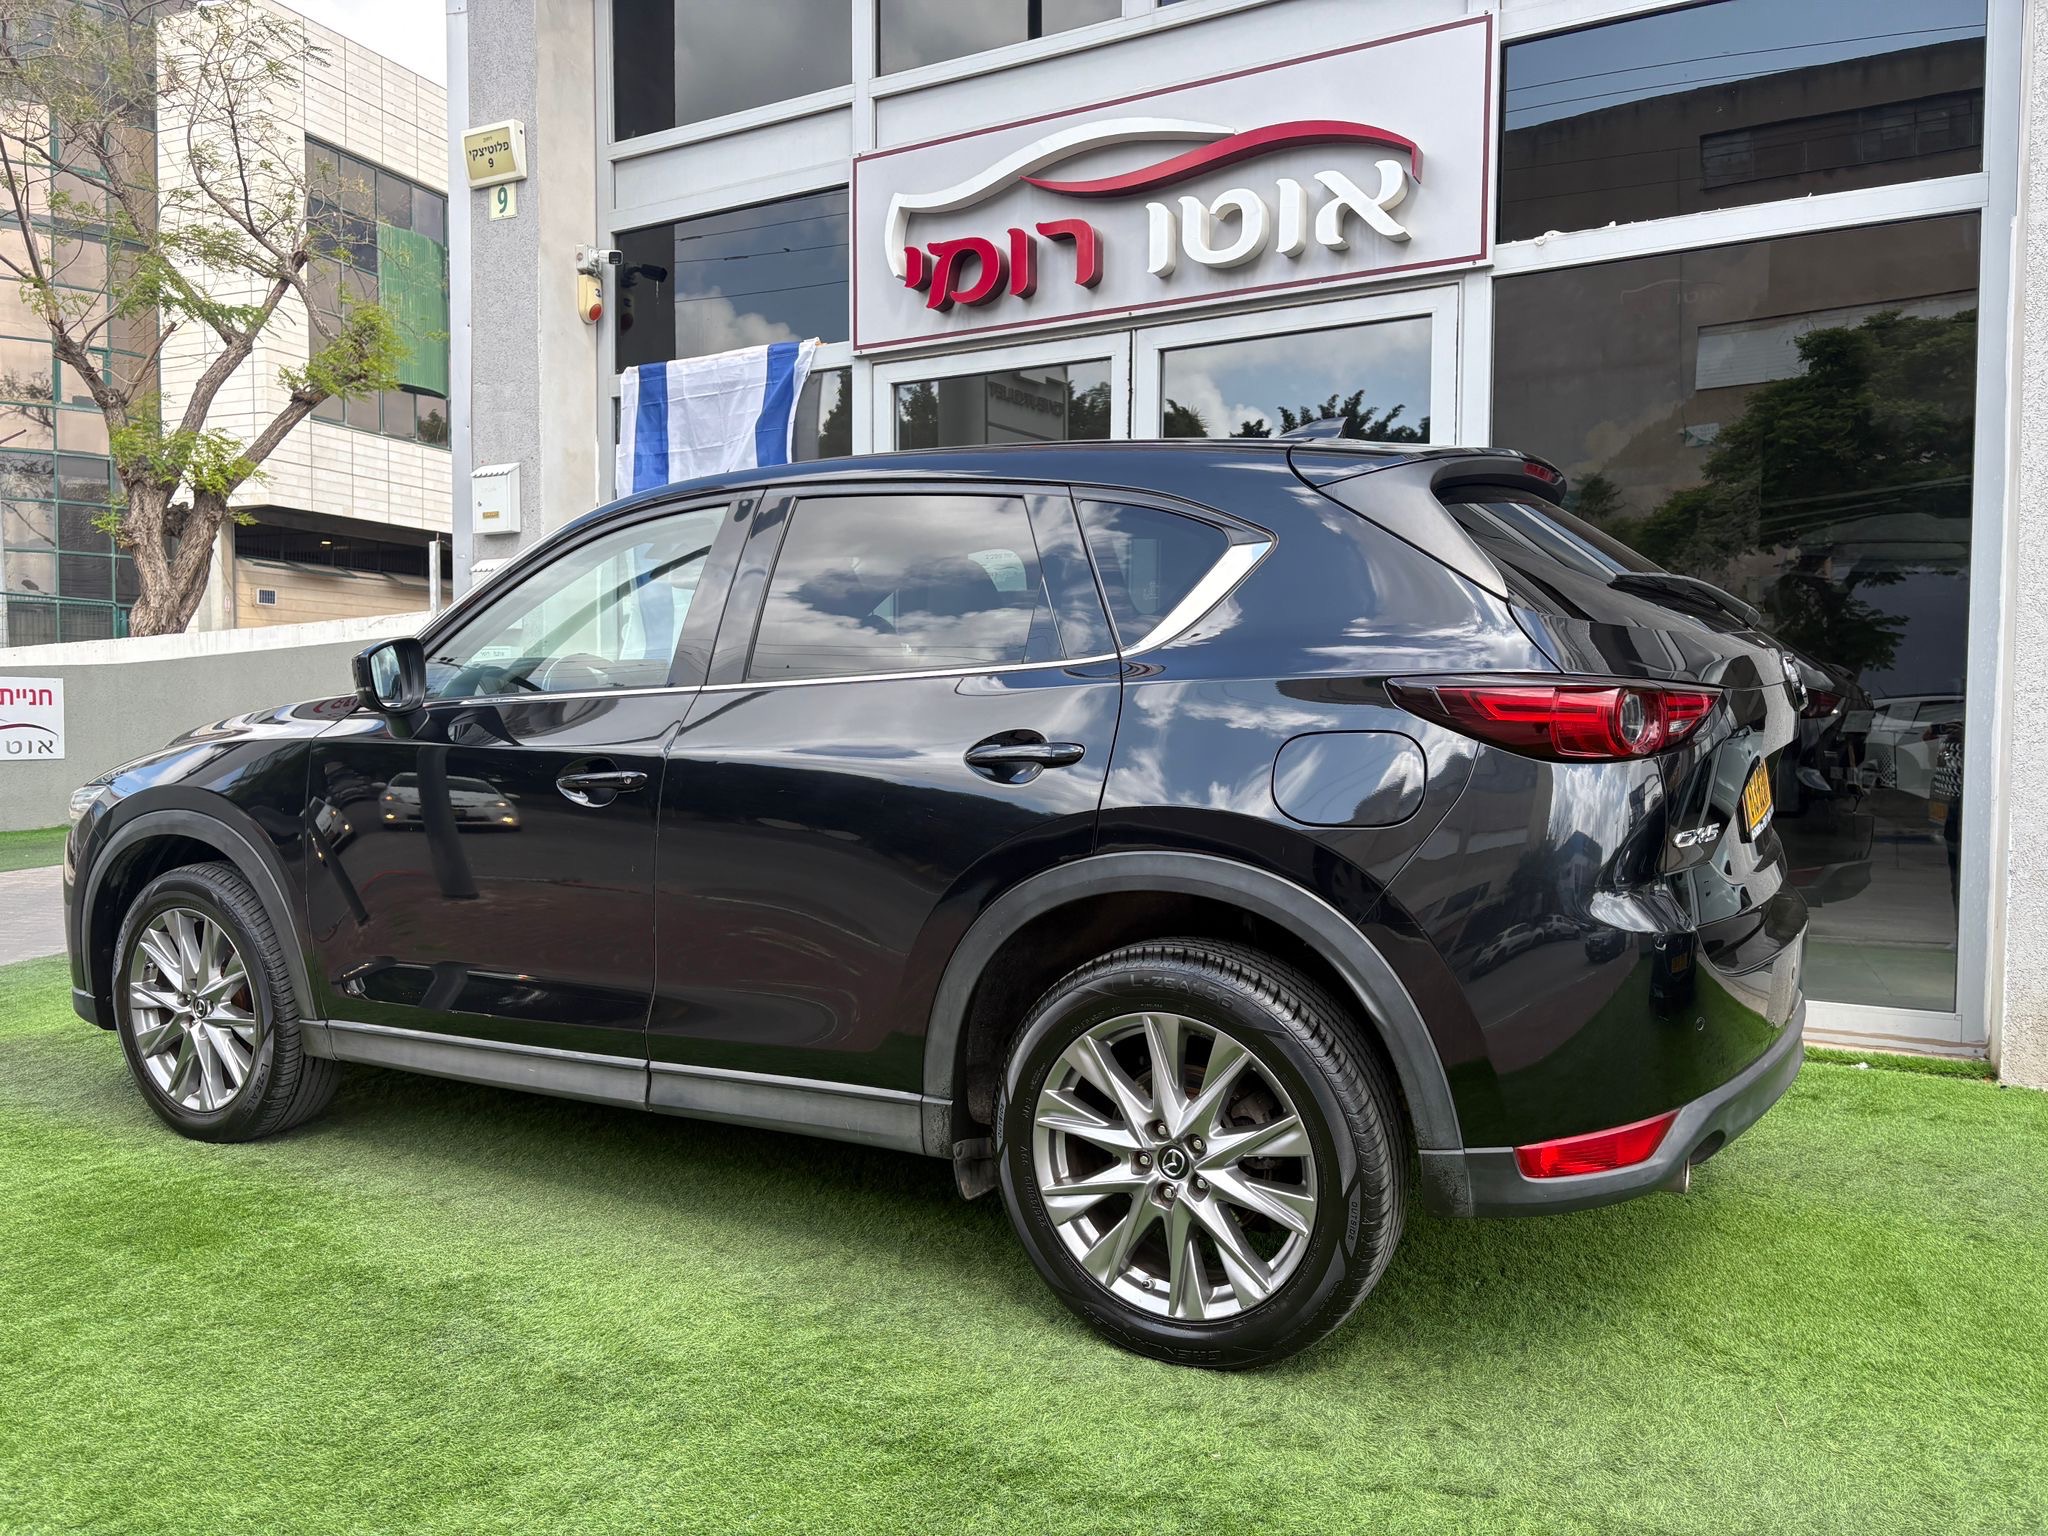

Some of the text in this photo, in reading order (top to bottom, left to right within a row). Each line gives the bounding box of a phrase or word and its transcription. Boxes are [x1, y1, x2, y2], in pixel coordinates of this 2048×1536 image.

[469, 141, 509, 161] פלוטיצקי
[488, 158, 494, 168] 9
[497, 186, 508, 214] 9
[903, 159, 1412, 312] אוטו רומי
[0, 688, 53, 706] חניית
[1348, 1201, 1359, 1241] OUTSIDE
